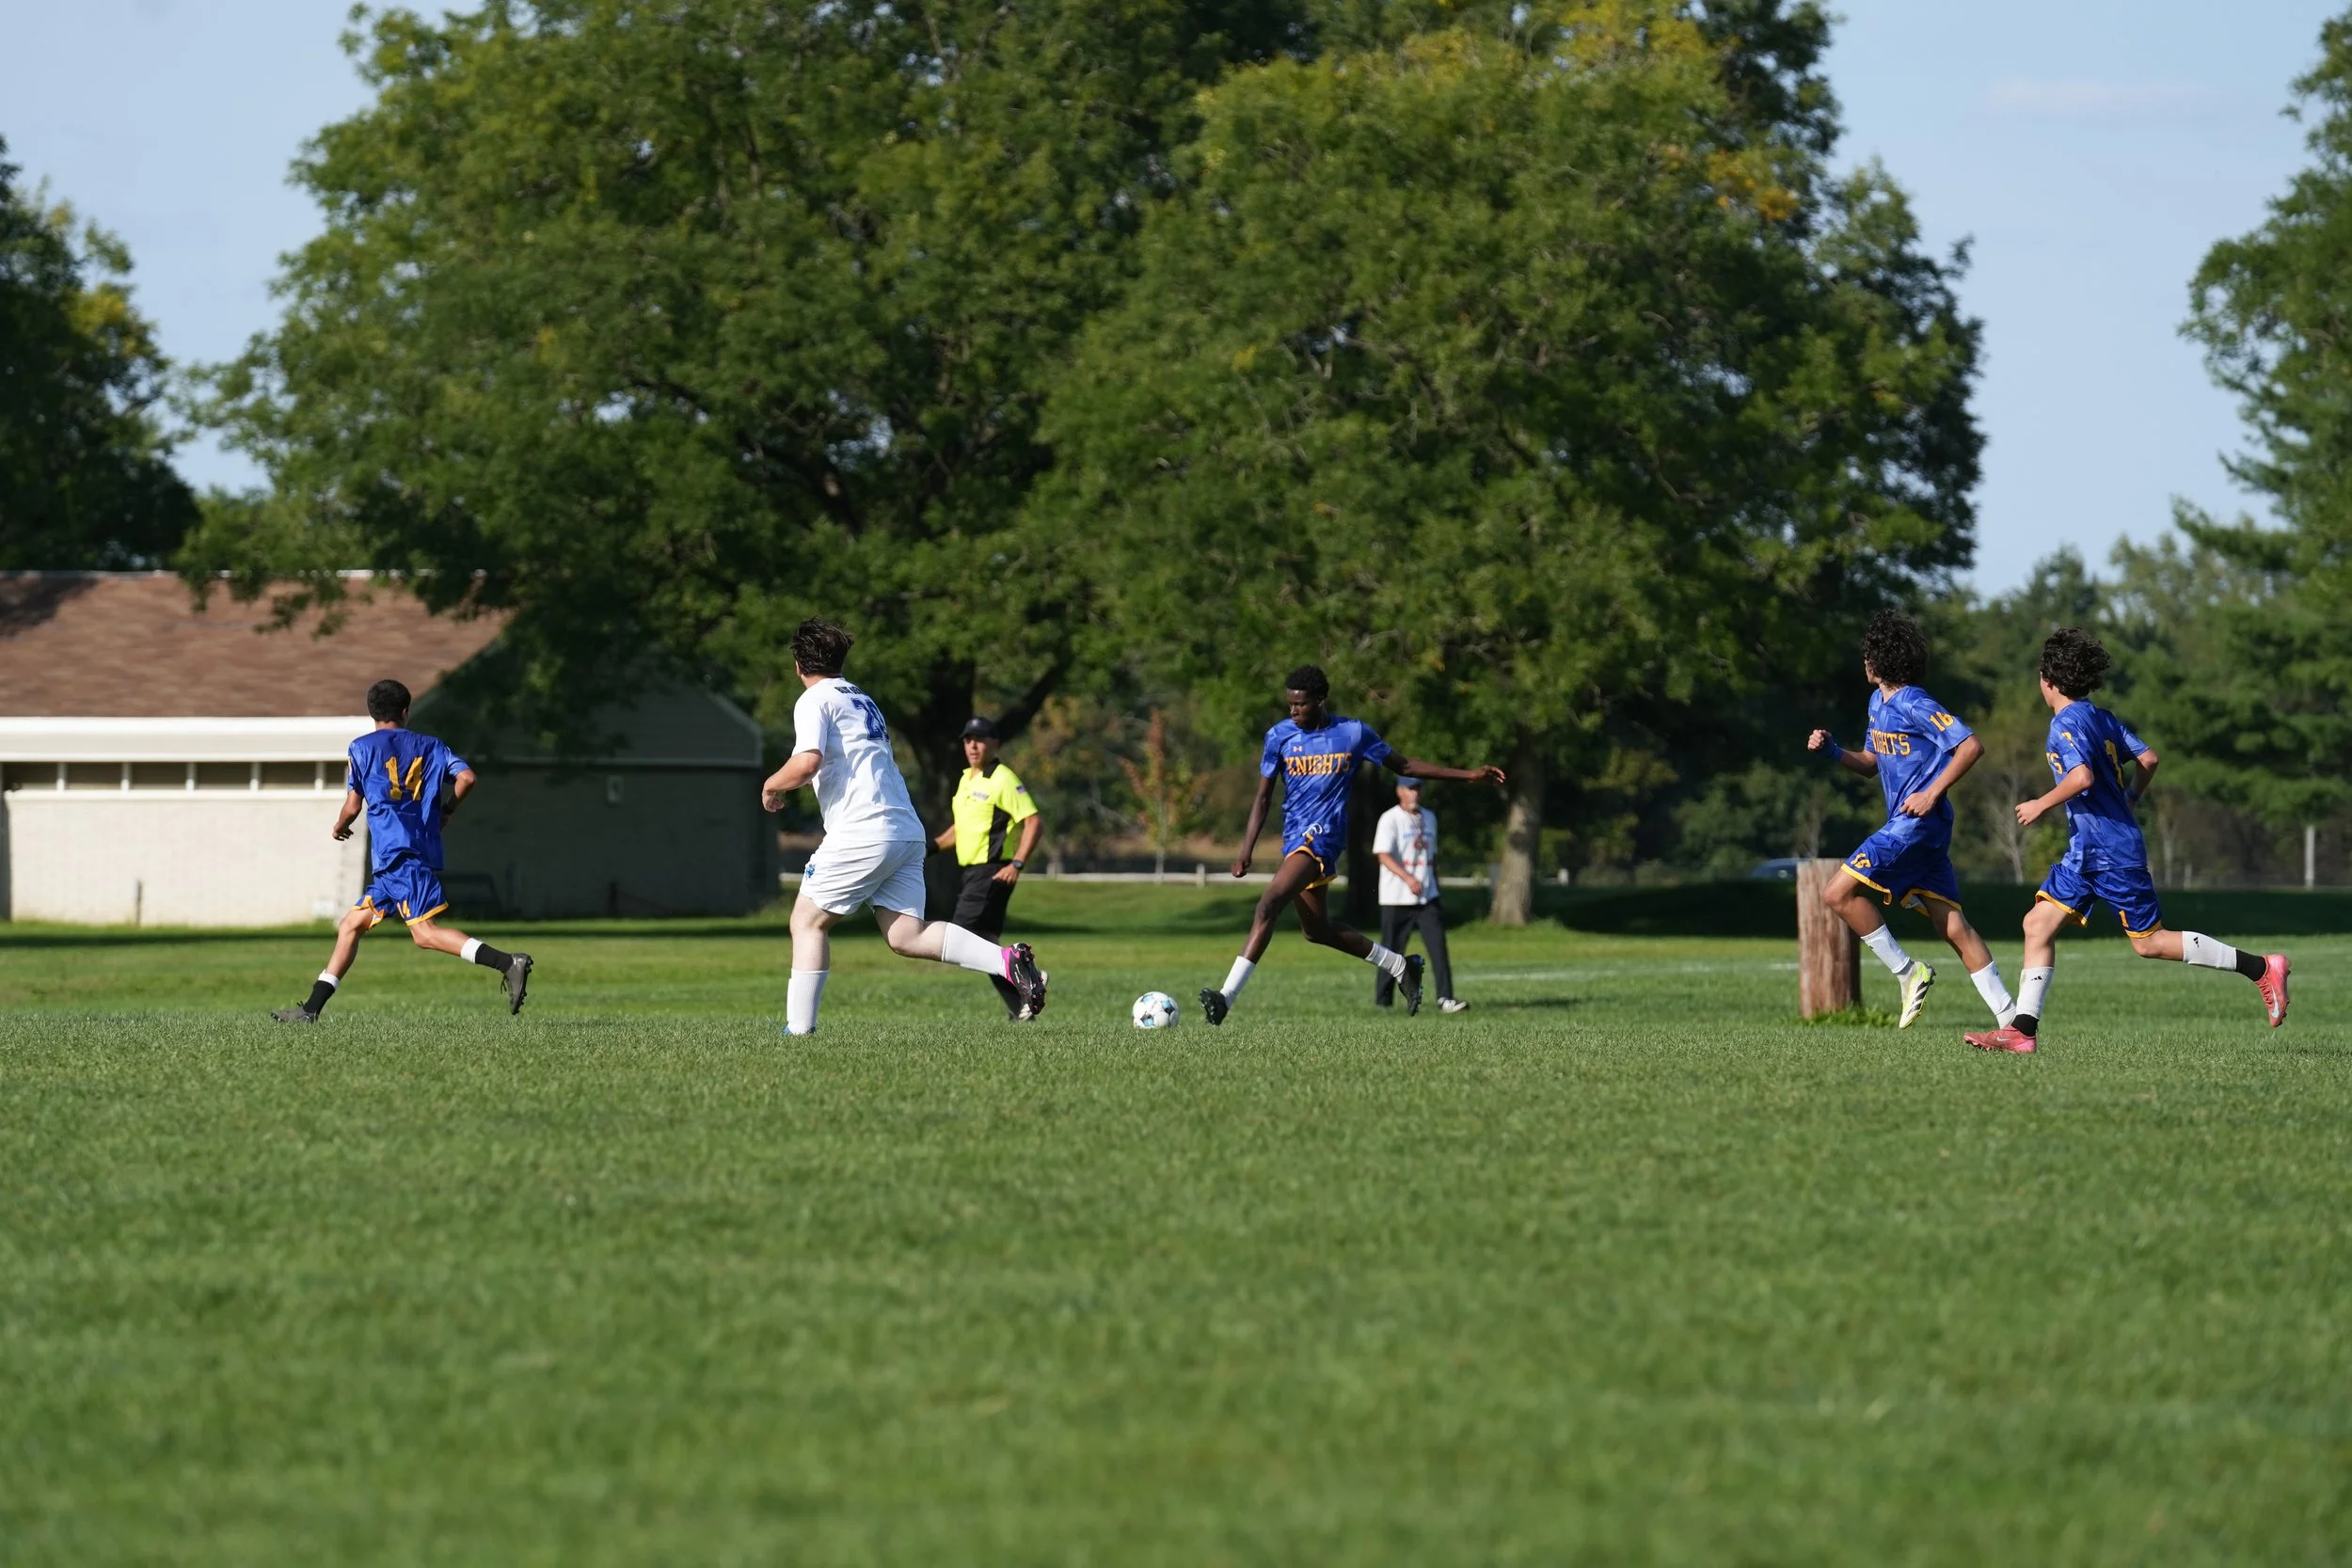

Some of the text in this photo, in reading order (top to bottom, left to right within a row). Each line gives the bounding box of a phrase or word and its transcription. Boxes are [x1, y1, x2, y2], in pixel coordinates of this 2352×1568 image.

[1930, 711, 1954, 732] 16
[1284, 752, 1352, 776] KNIGHTS
[385, 755, 423, 801] 14
